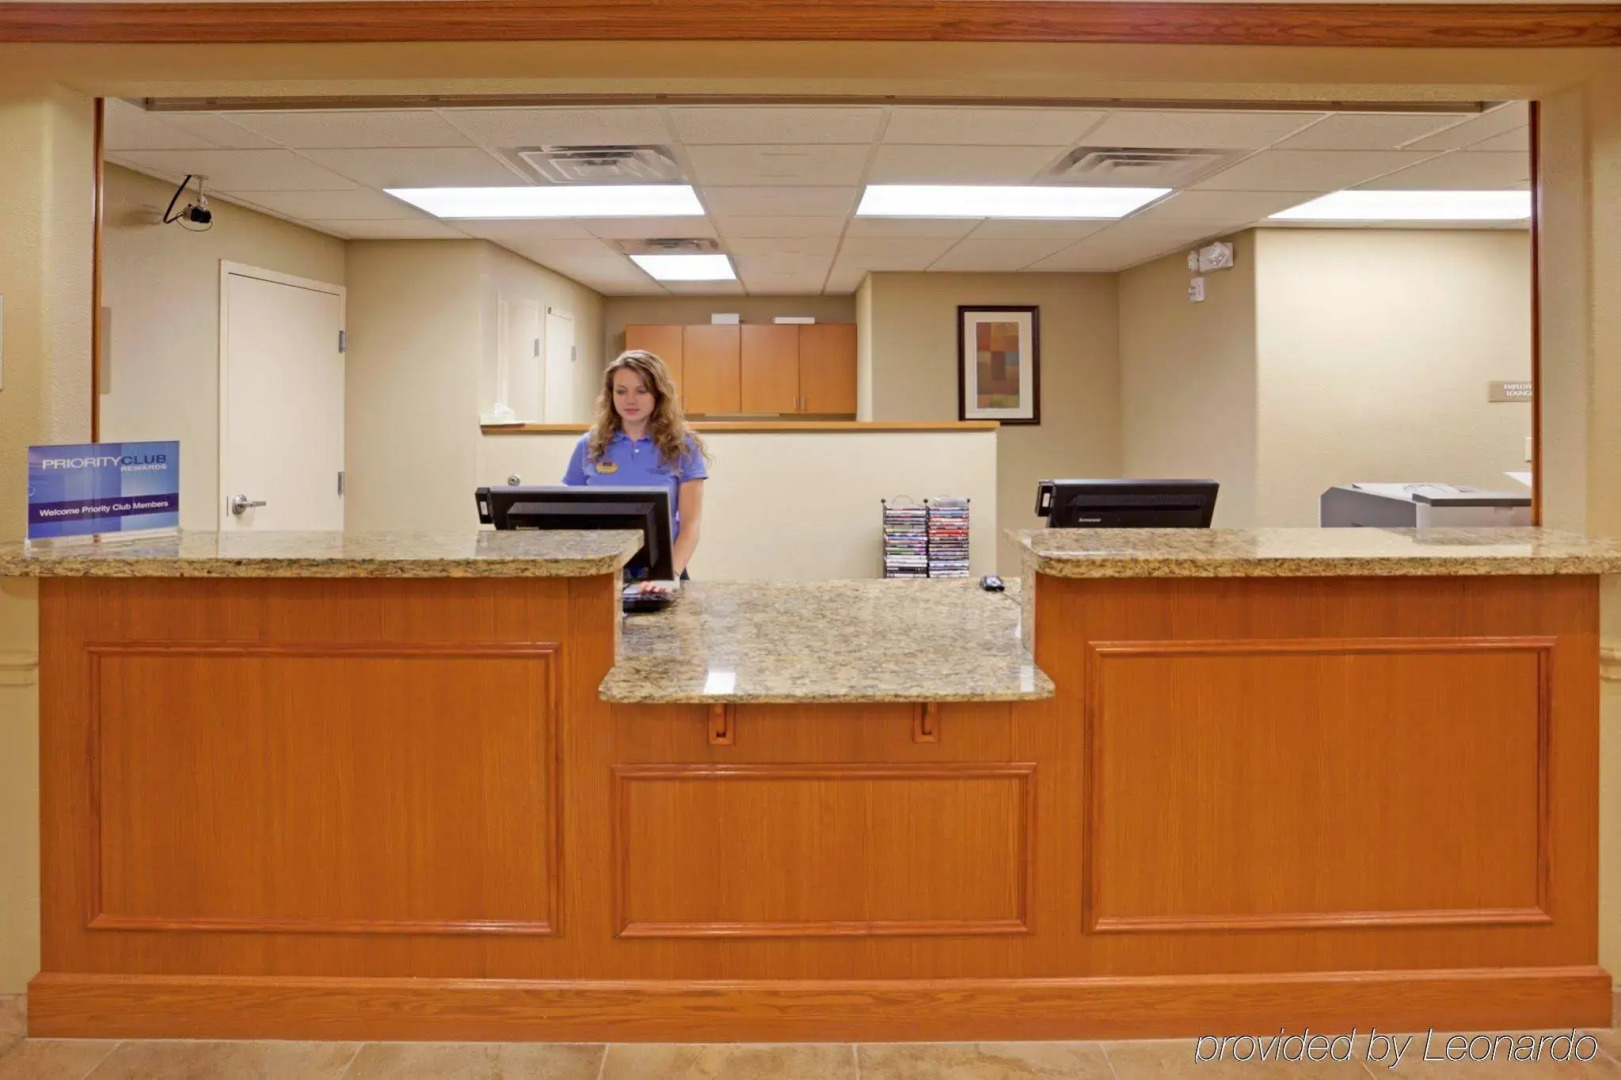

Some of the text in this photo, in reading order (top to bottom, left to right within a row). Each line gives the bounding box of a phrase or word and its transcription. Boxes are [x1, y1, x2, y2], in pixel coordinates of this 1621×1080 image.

[121, 464, 167, 472] REWARDS
[39, 500, 169, 517] Welcome Priority Club Members
